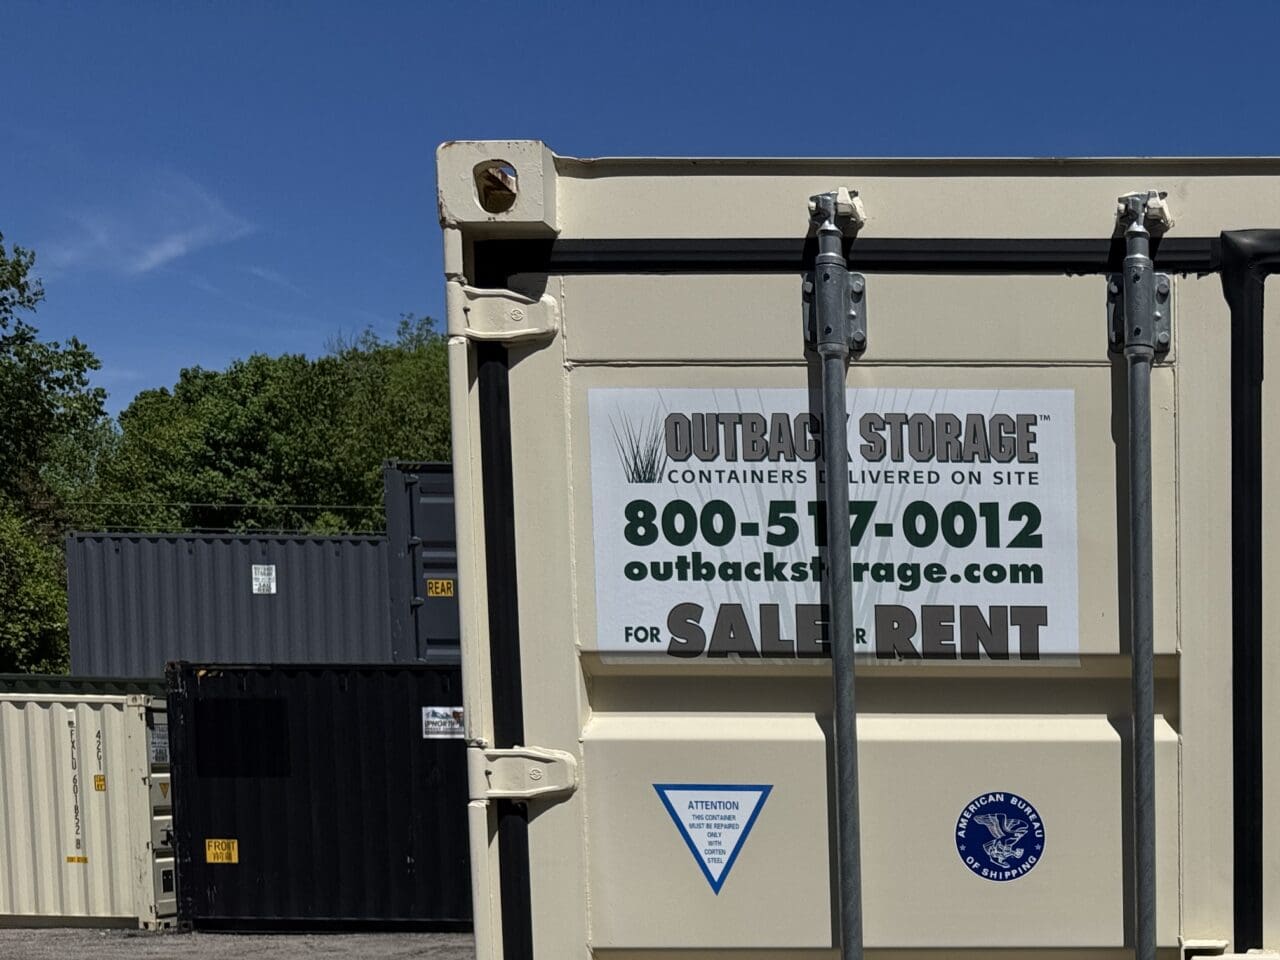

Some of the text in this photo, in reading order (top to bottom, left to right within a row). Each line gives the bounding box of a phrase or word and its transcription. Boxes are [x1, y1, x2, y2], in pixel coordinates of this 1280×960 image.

[664, 412, 852, 462] OUTBAC
[859, 412, 1038, 463] STORAGE
[668, 469, 1039, 486] CONTAINERS LIVERED ON SITE
[428, 581, 453, 594] REAR
[624, 552, 1043, 591] outbackstrage.com
[624, 626, 661, 645] FOR
[667, 603, 832, 659] SALE
[875, 605, 1048, 661] RENT
[69, 729, 78, 771] FXLU
[688, 801, 739, 810] ATTENTION
[958, 794, 1043, 838] AMERICAN BUREAU
[966, 855, 1037, 879] OF SHIPPING
